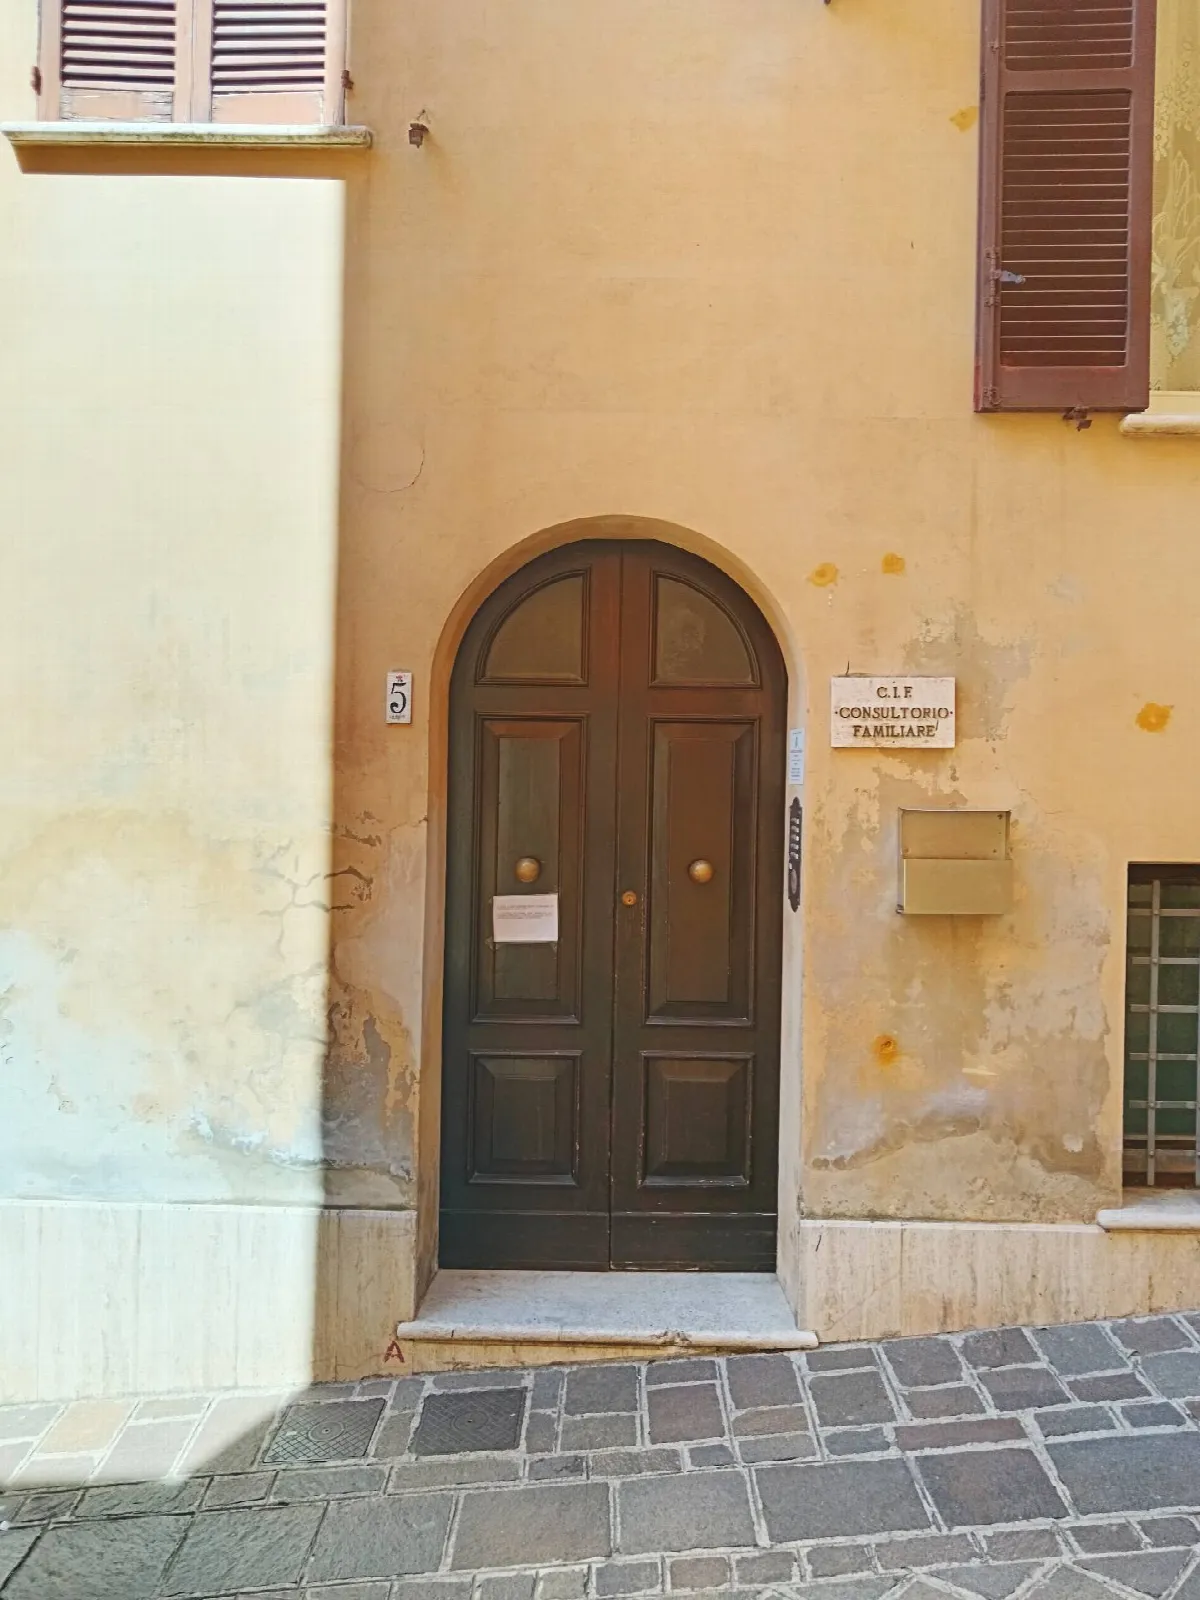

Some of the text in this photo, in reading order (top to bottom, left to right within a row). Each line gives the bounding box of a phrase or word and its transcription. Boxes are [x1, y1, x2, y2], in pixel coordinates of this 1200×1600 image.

[390, 682, 406, 713] 5
[839, 706, 949, 719] CONSULTORIO
[852, 724, 935, 737] FAMILIARE
[384, 1340, 405, 1363] A
